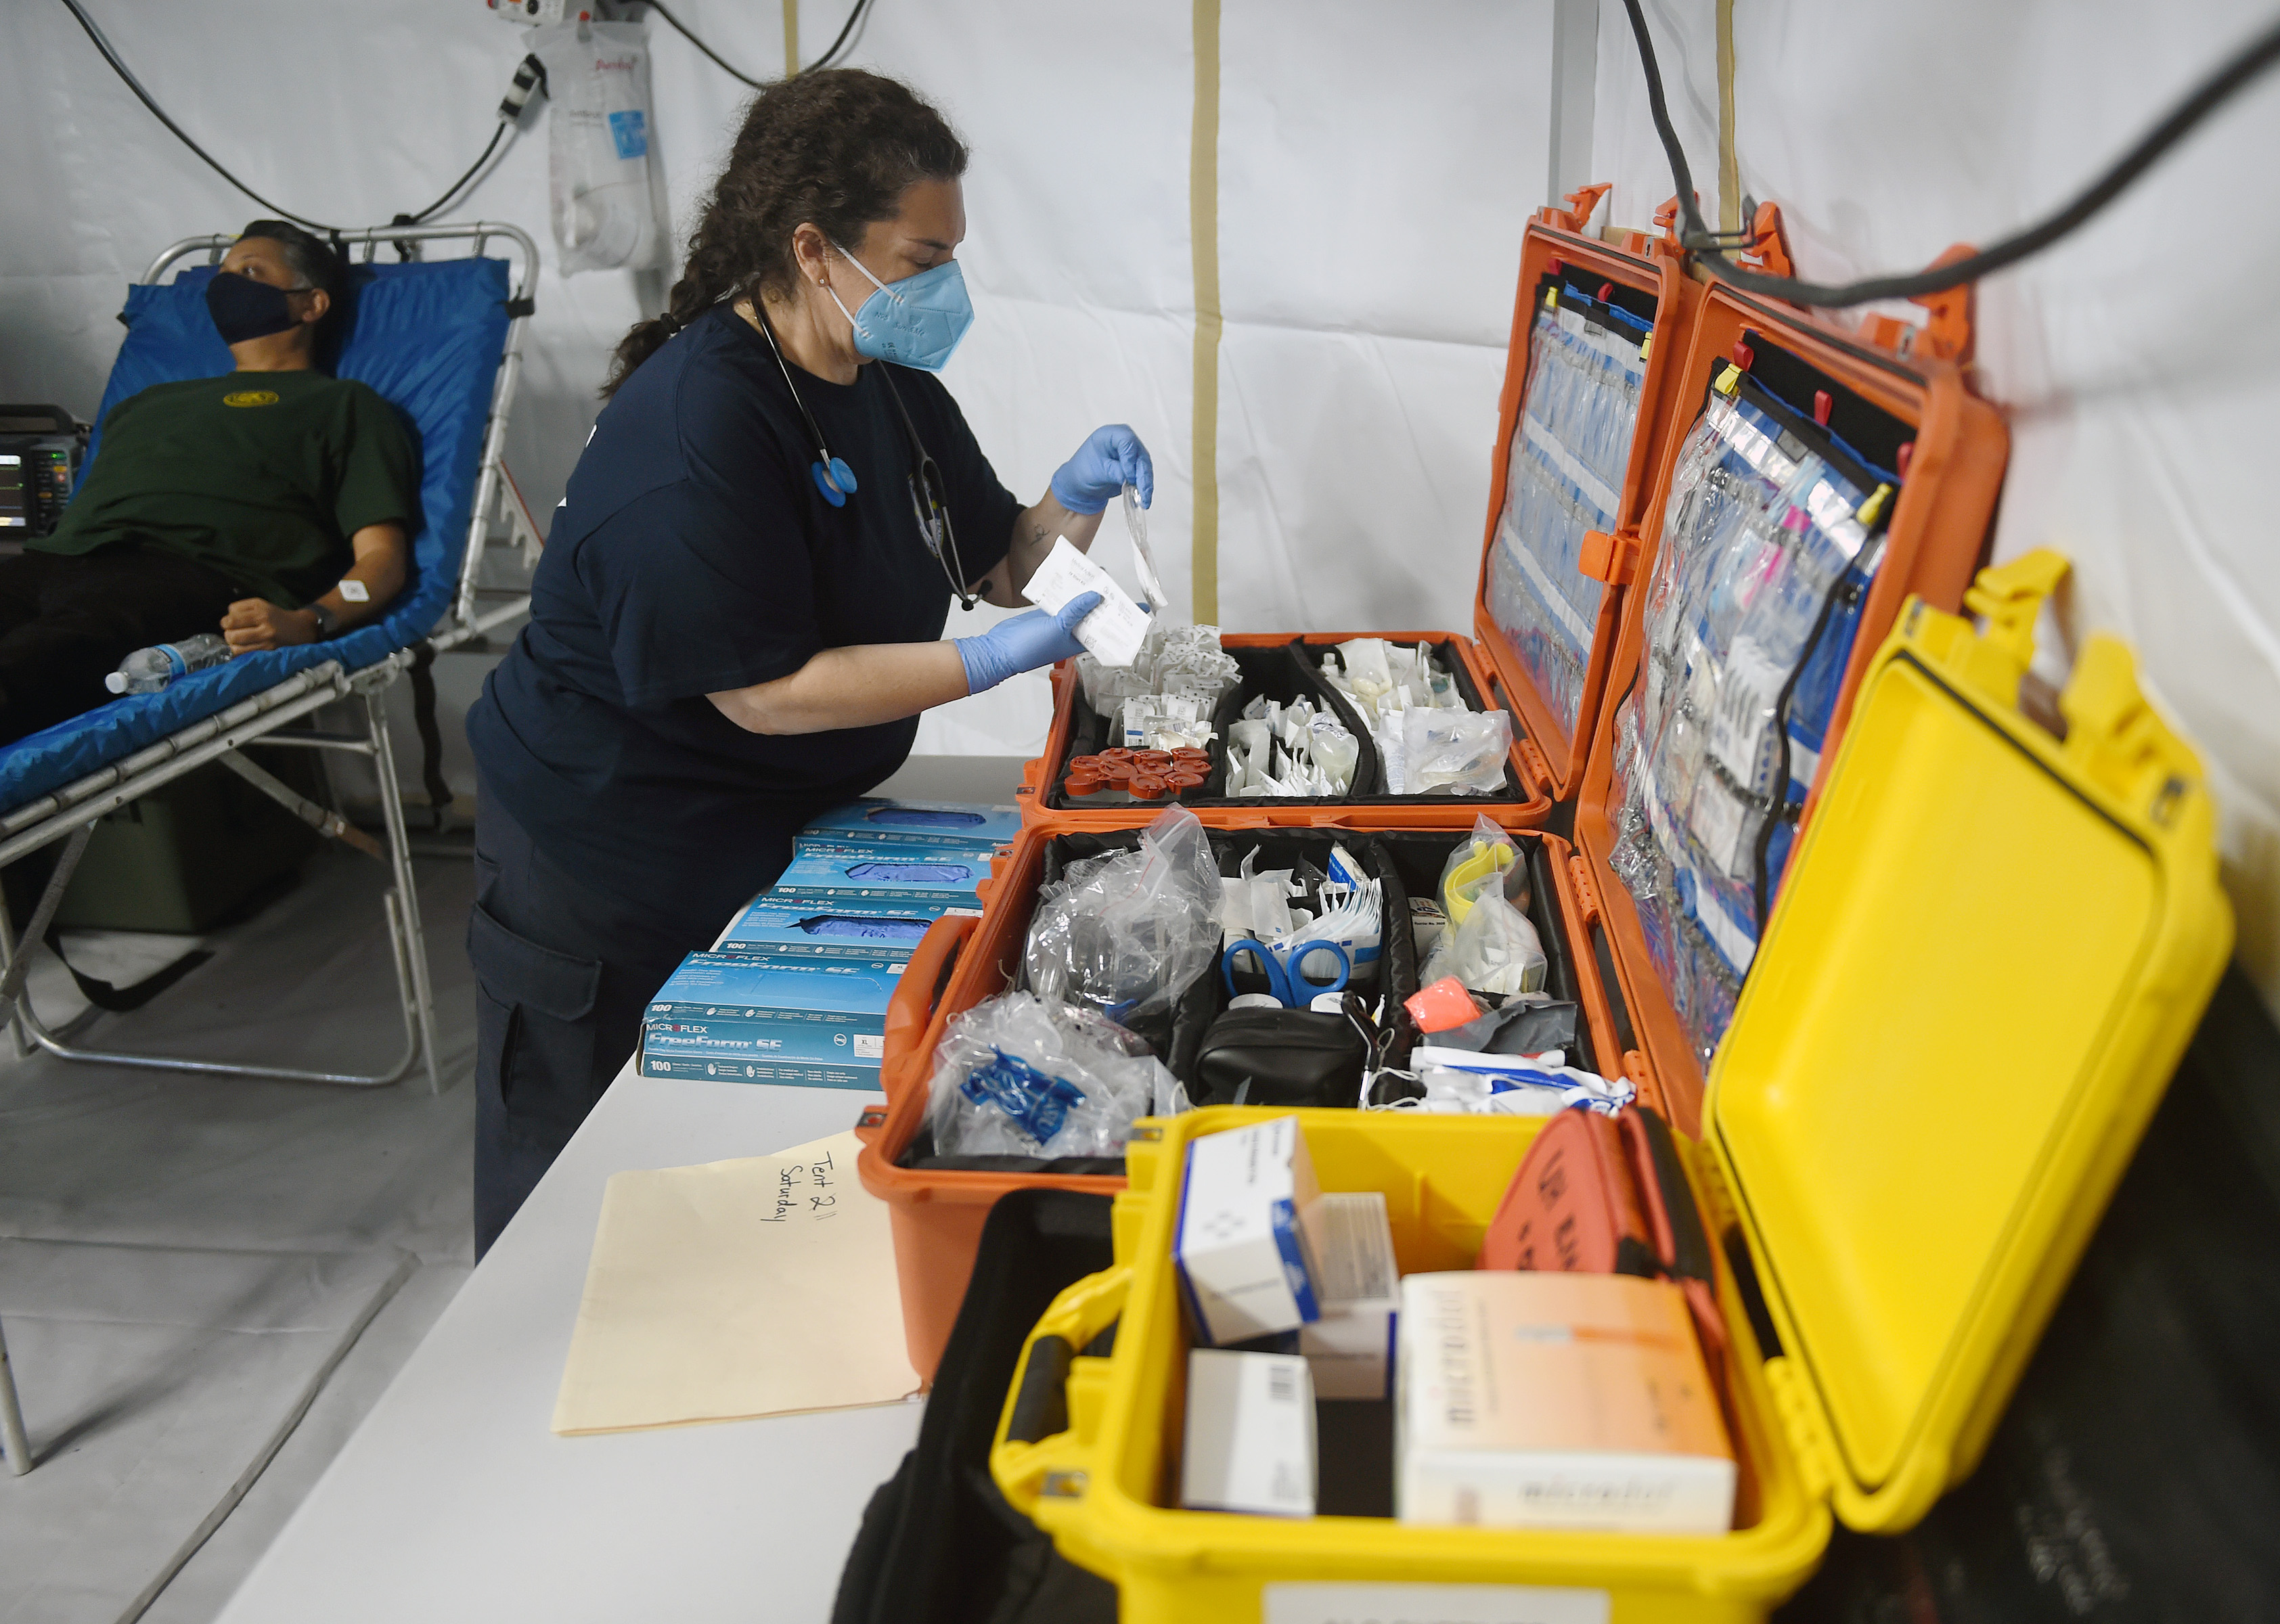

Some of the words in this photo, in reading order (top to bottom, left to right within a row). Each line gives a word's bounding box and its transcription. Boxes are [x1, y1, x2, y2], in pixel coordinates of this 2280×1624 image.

[761, 897, 835, 905] MICROFLEX
[692, 953, 771, 962] MICROFLEX
[646, 1023, 708, 1034] MICROFLEX
[648, 1032, 749, 1050] FreeForm
[756, 1039, 784, 1052] SE
[650, 1060, 671, 1072] 100
[812, 1151, 834, 1188] Tent
[760, 1165, 803, 1222] Saturday
